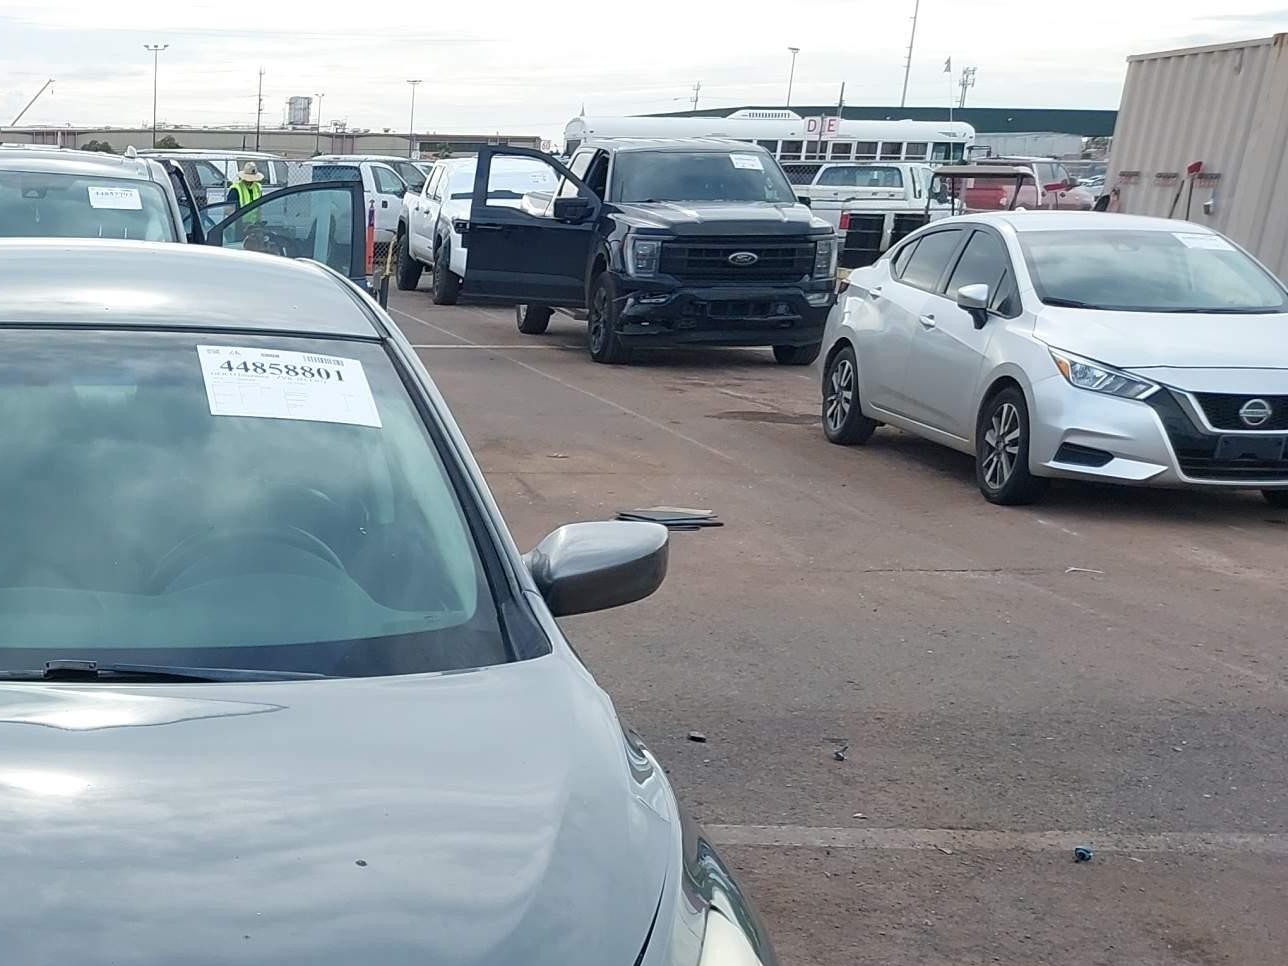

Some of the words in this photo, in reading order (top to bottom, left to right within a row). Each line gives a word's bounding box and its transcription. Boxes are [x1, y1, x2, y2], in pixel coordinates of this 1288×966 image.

[807, 118, 817, 132] D
[827, 118, 837, 132] E
[219, 360, 344, 382] 44858801
